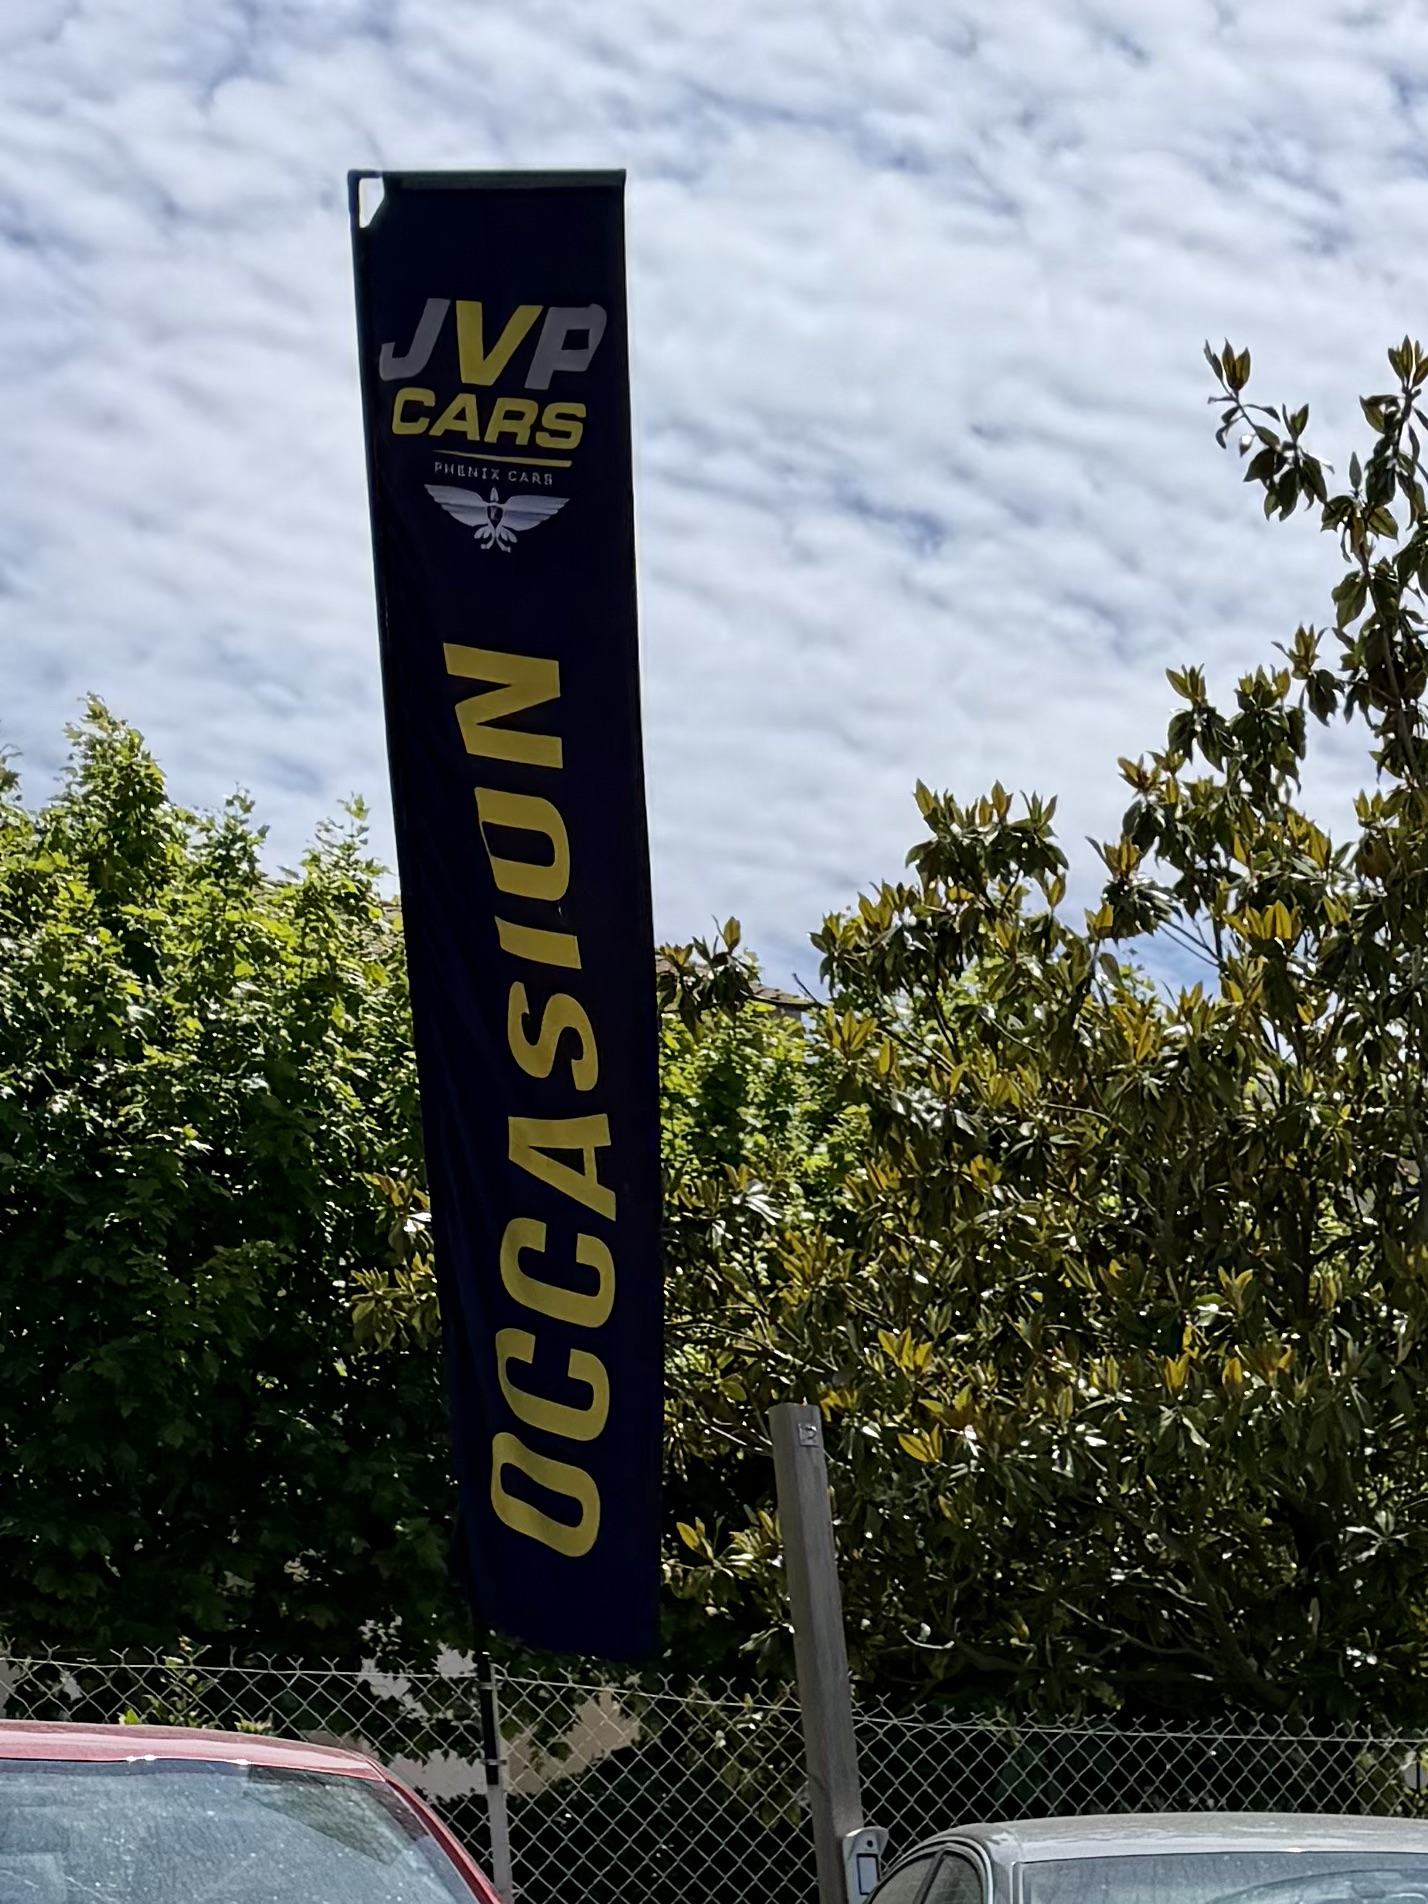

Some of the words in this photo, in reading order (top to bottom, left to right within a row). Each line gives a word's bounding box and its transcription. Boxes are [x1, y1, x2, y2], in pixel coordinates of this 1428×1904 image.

[379, 297, 608, 391] JVP
[391, 386, 587, 450] CARS
[442, 641, 617, 1557] OCCASION
